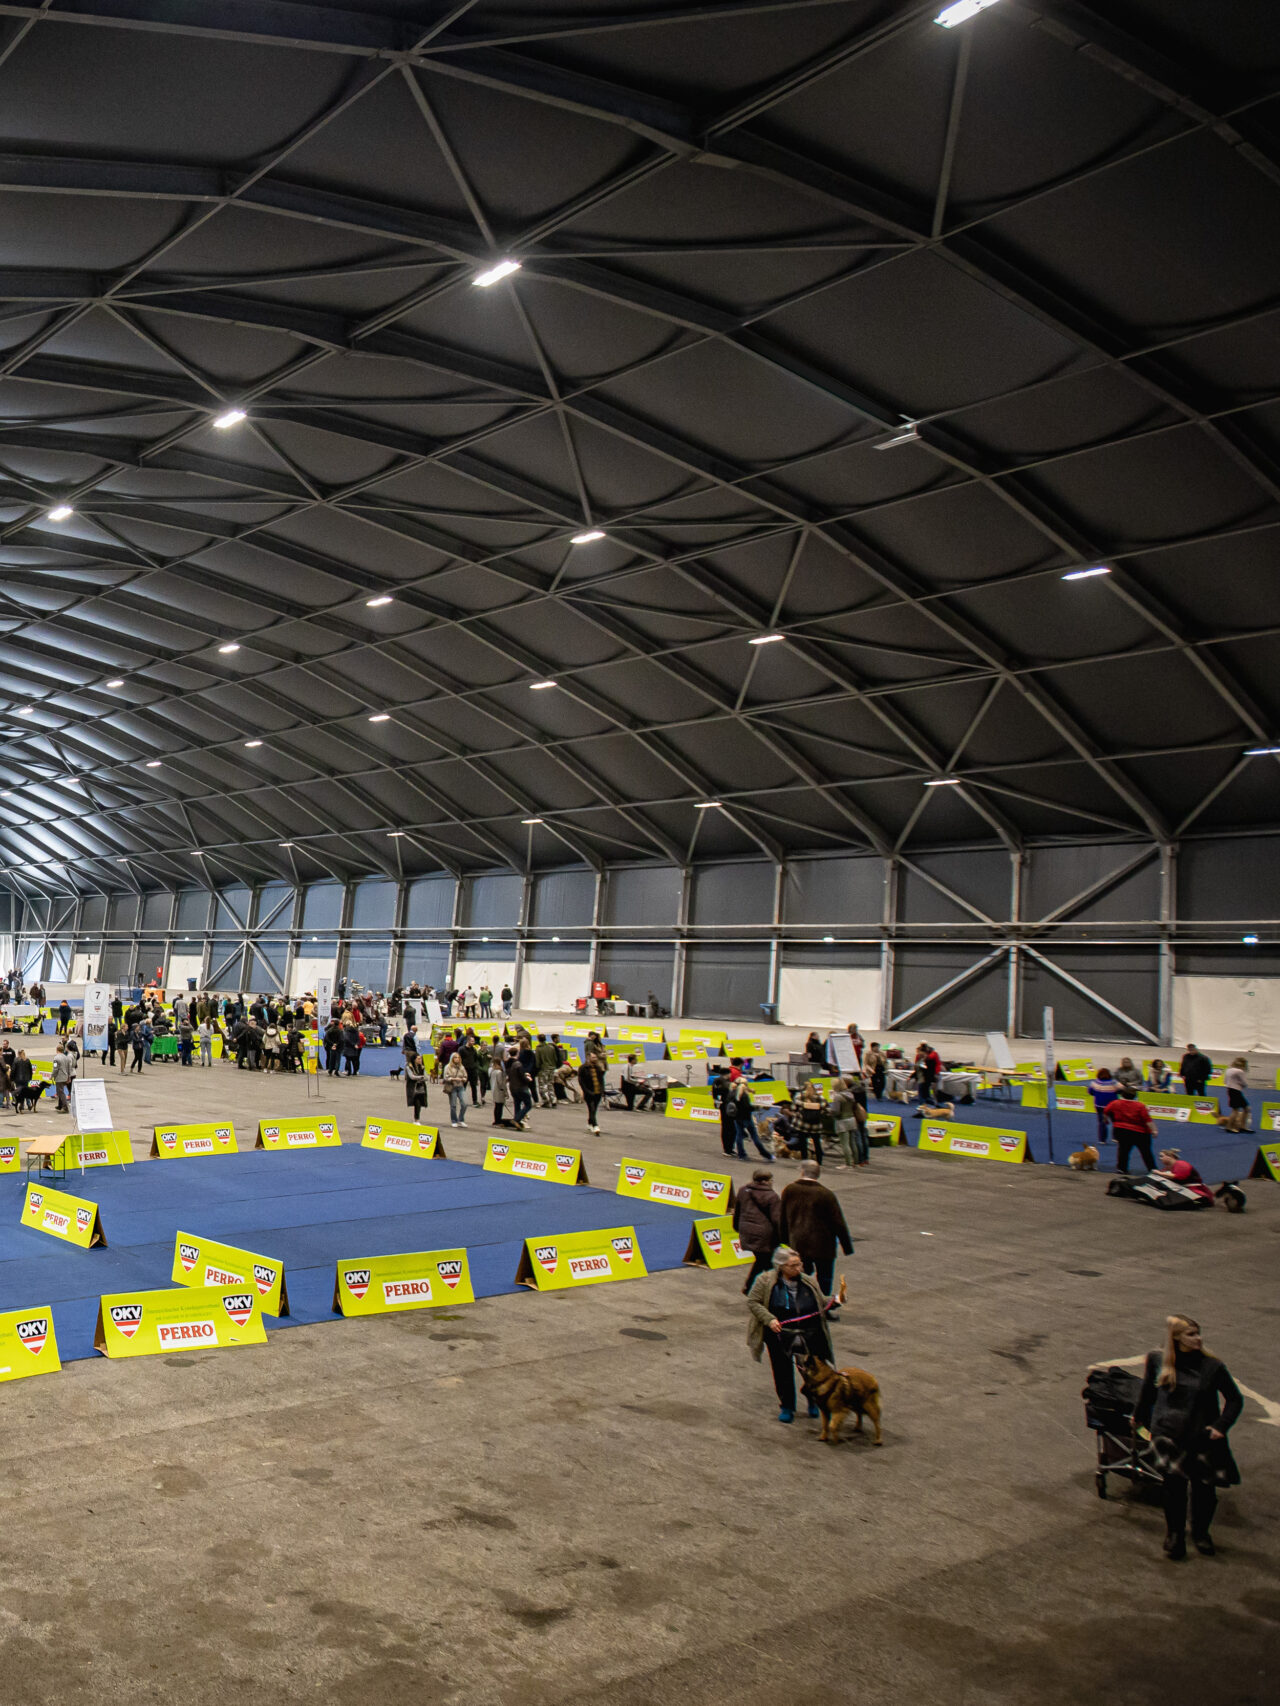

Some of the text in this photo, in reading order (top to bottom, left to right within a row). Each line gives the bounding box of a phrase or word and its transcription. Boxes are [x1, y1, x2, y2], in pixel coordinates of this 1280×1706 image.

[95, 991, 101, 999] 7
[288, 1133, 315, 1141] PERRO
[386, 1137, 411, 1148] PERRO
[184, 1140, 212, 1149] PERRO
[514, 1160, 546, 1172] PERRO
[652, 1185, 690, 1199] PERRO
[571, 1258, 609, 1273] PERRO
[385, 1283, 430, 1297] PERRO
[160, 1324, 214, 1341] PERRO
